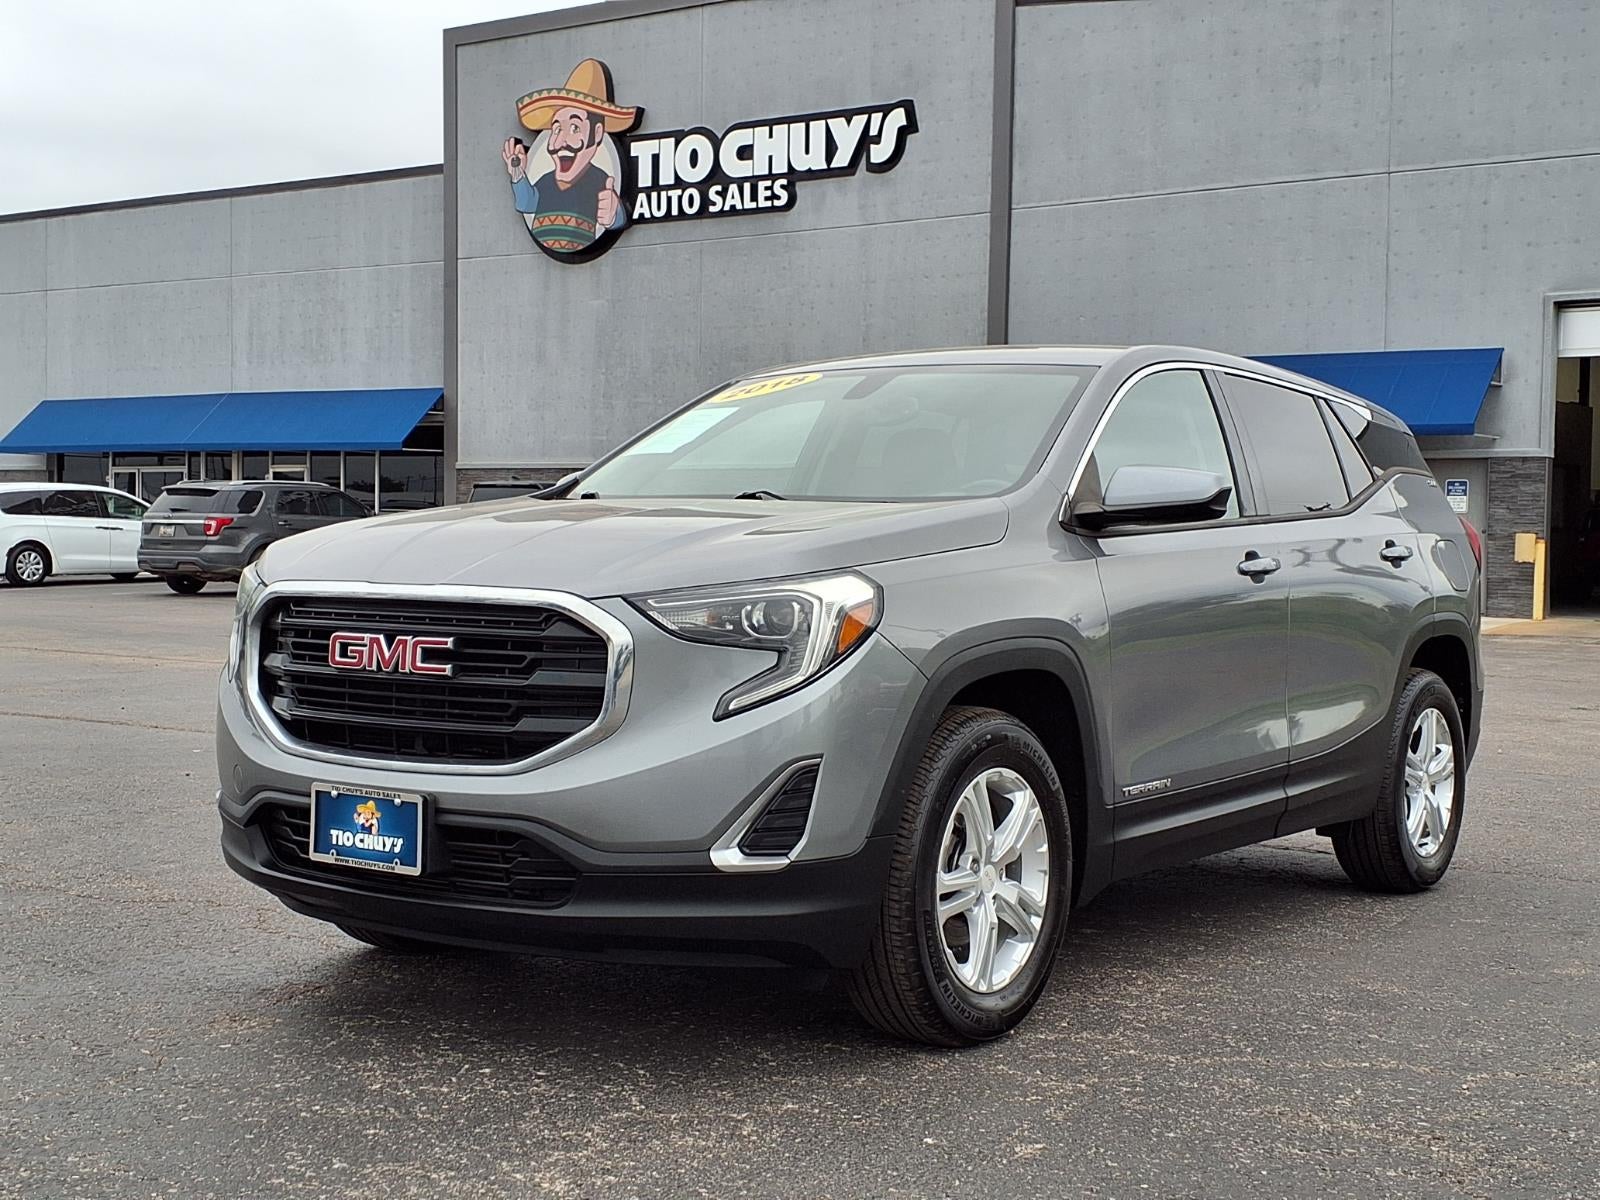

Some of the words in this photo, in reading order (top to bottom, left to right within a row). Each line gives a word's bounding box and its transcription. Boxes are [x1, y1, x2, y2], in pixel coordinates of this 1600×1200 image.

[630, 133, 714, 188] TIO
[718, 106, 908, 178] CHUY'S
[631, 187, 700, 220] AUTO
[708, 178, 788, 212] SALES
[328, 632, 454, 676] GMC
[341, 787, 363, 795] CHUY'S
[364, 789, 381, 797] AUTO
[382, 791, 402, 799] SALES
[1121, 777, 1172, 797] TERRAIN
[330, 829, 354, 847] TIO
[354, 833, 404, 854] CHUY'S
[334, 857, 396, 872] WWW.TIOCHUYS.COM
